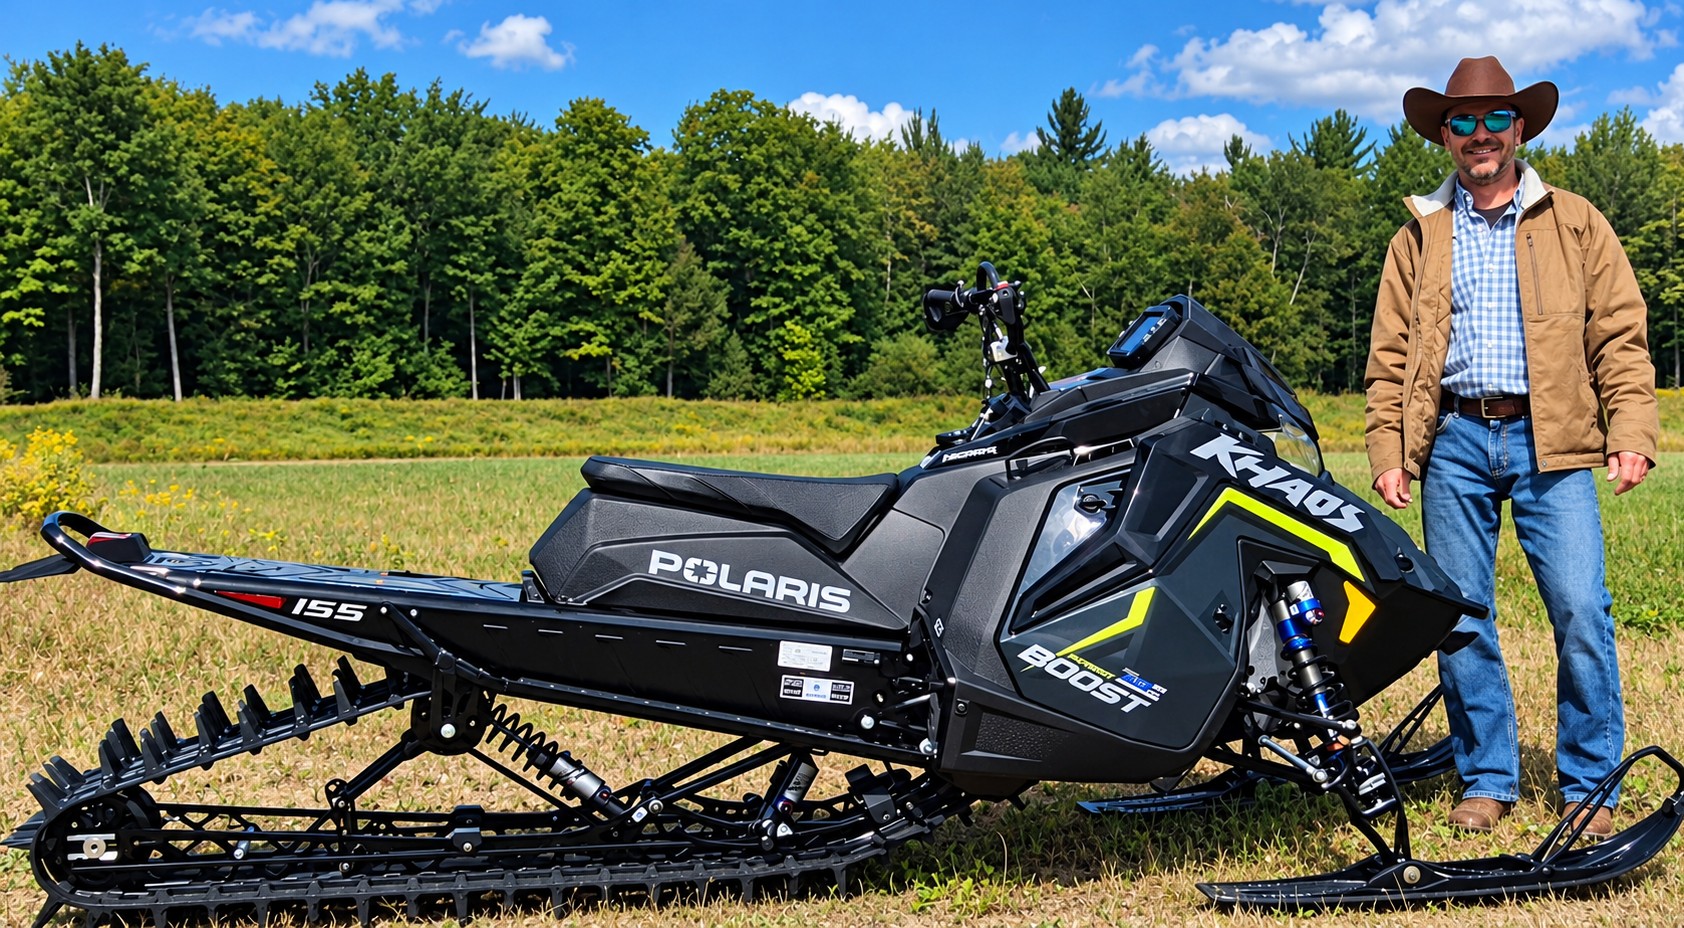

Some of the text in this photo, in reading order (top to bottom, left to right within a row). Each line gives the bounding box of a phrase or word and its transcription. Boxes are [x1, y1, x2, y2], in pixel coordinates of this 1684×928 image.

[1190, 433, 1365, 533] KHAOS
[291, 598, 368, 622] 155
[648, 549, 851, 613] POLARIS
[1017, 643, 1151, 713] BOOST
